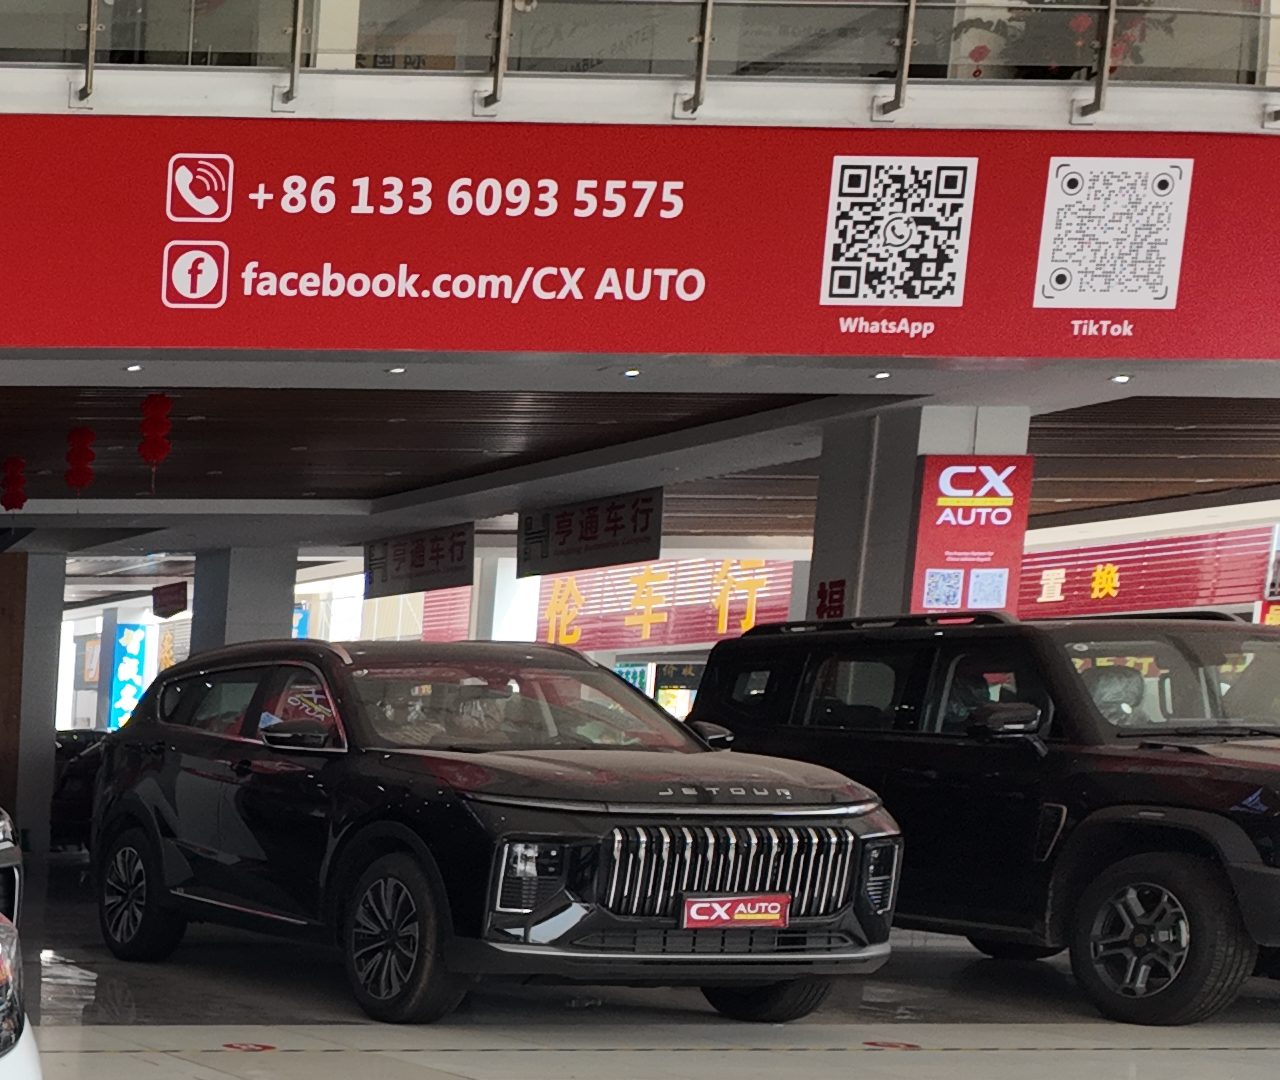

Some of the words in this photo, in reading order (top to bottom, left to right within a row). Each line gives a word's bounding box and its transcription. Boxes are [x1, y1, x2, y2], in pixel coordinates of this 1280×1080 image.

[248, 175, 336, 214] +86
[350, 177, 433, 215] 133
[447, 178, 558, 218] 6093
[573, 180, 685, 219] 5575
[241, 262, 585, 304] facebook.com/CX
[595, 268, 706, 302] AUTO
[839, 317, 935, 338] WhatsApp
[1071, 320, 1133, 337] TikTok
[938, 465, 1016, 497] CX
[936, 507, 1012, 525] AUTO
[690, 902, 731, 920] CX
[735, 902, 781, 914] AUTO
